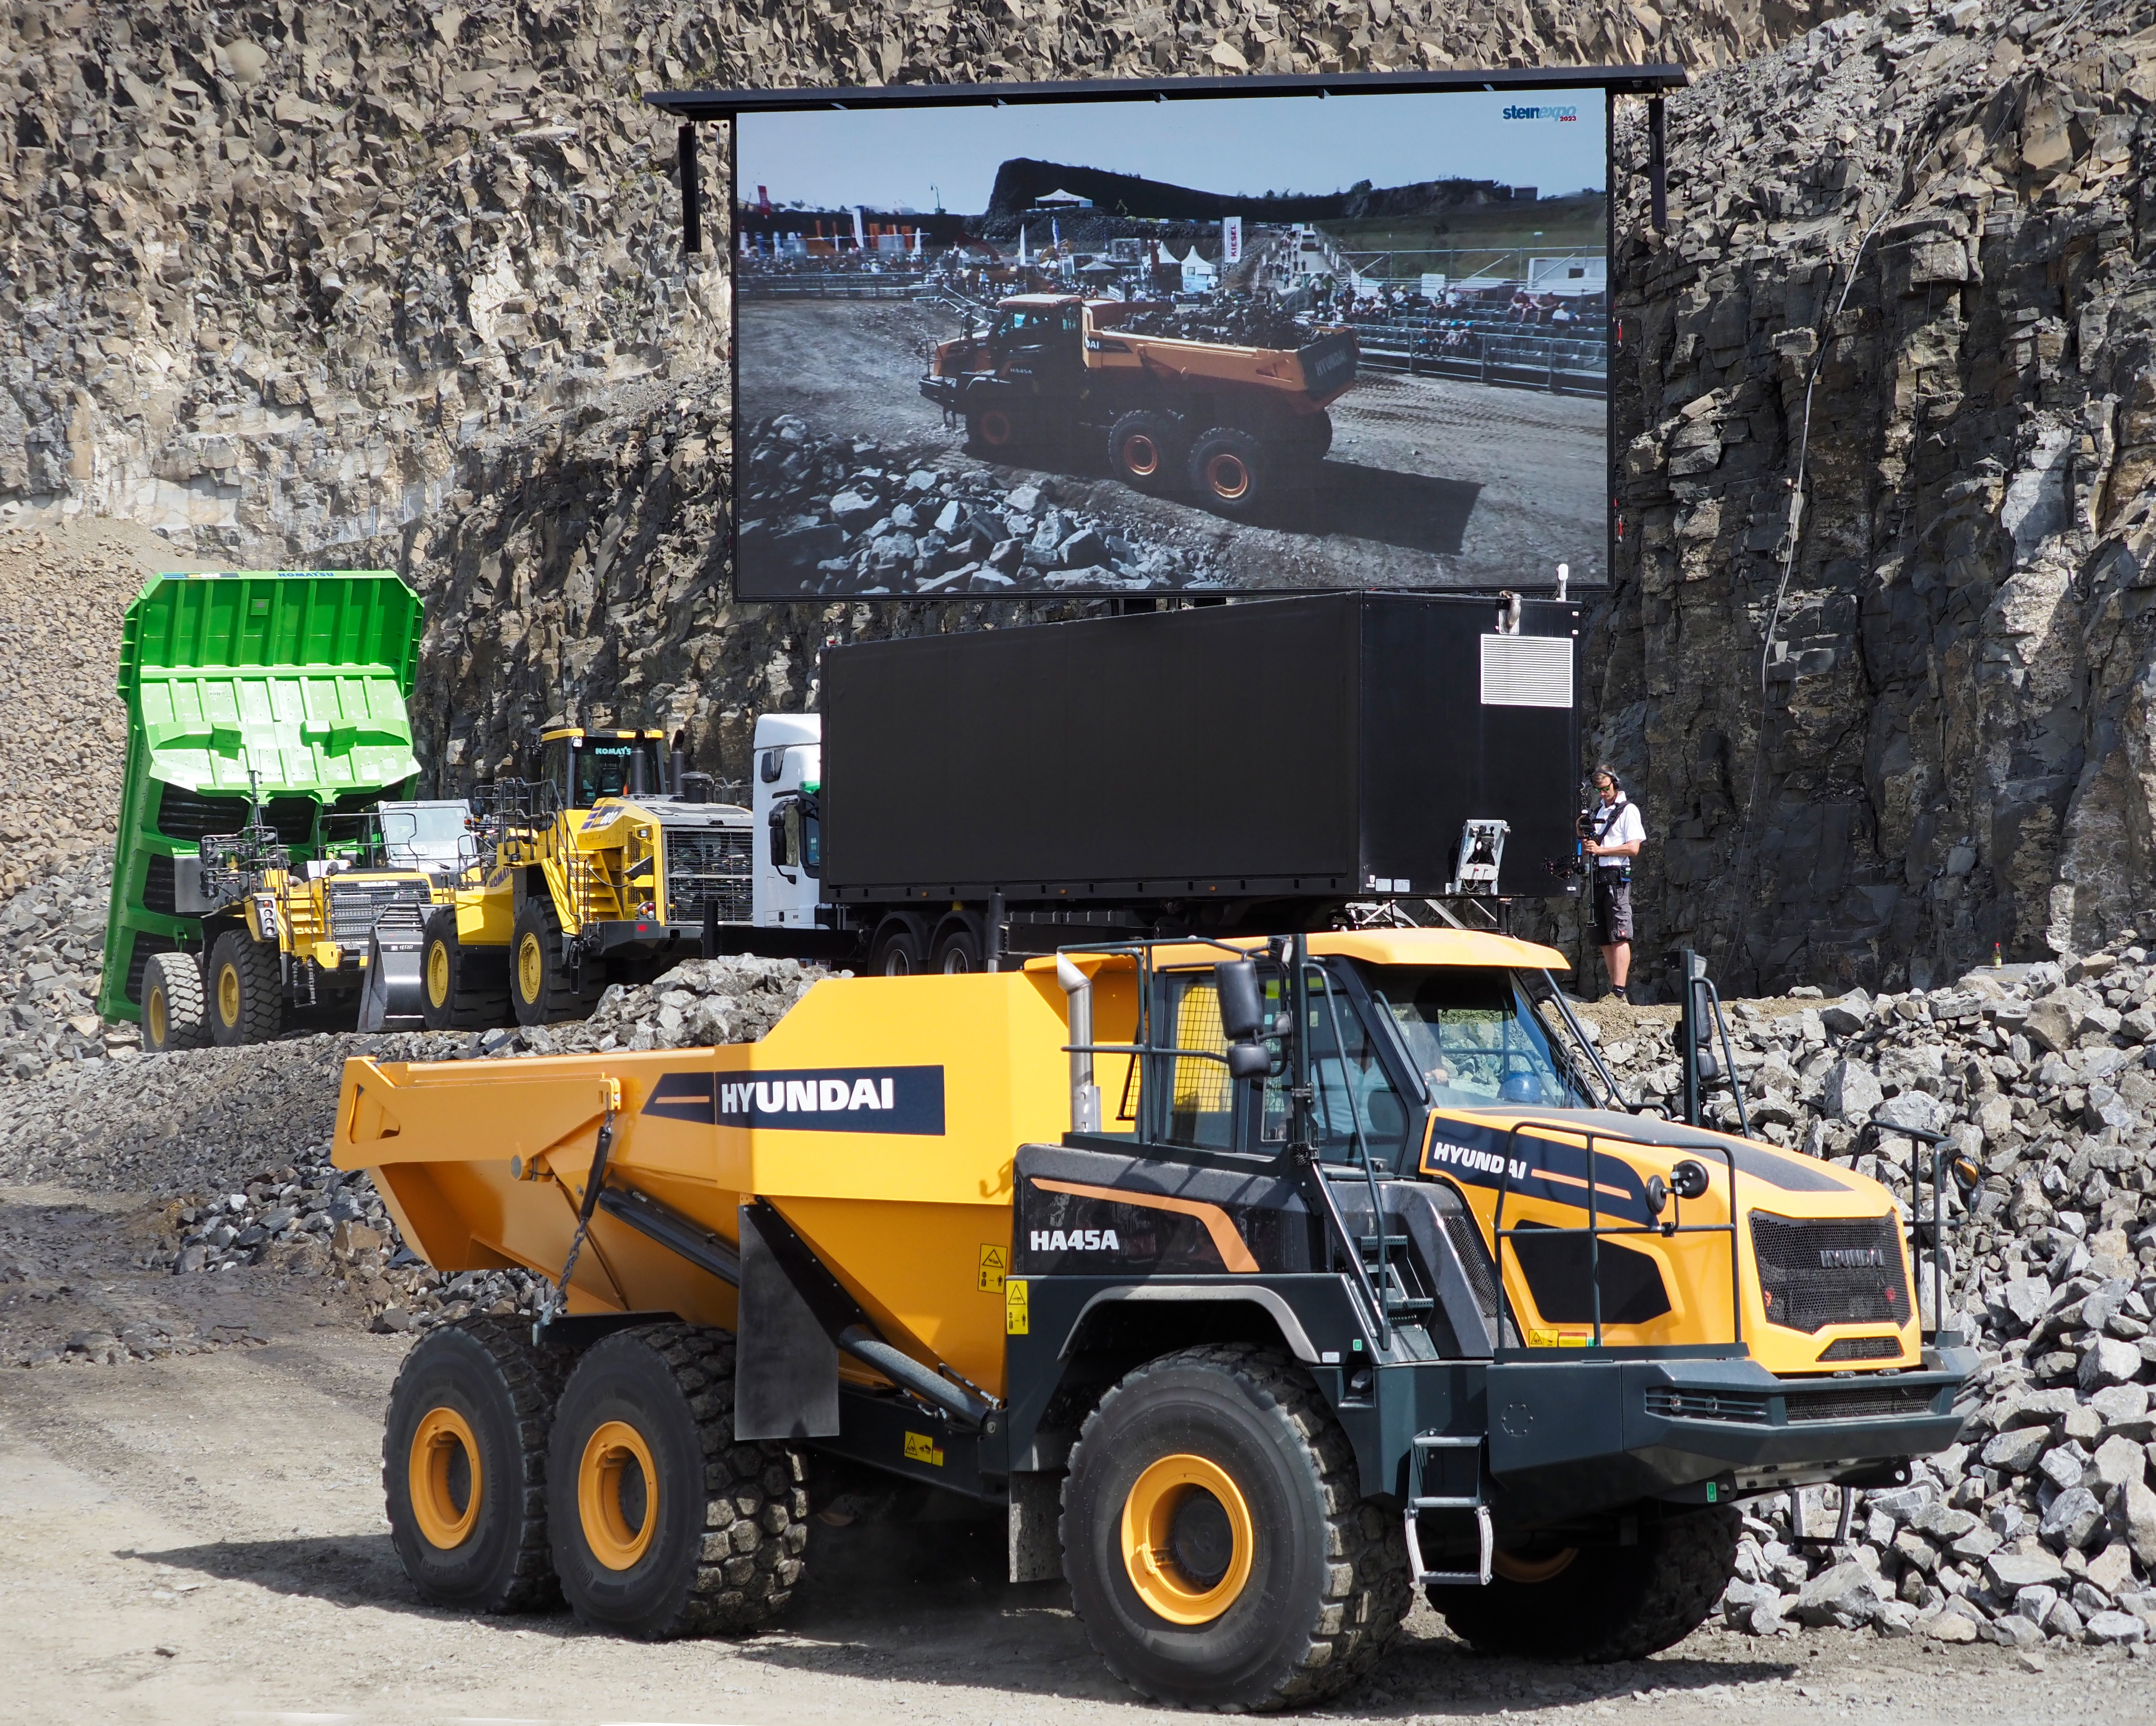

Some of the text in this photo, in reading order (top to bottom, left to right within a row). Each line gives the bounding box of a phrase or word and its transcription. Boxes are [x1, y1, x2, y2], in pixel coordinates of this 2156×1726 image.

[1502, 105, 1577, 122] steinexpo
[595, 746, 632, 755] KOMATS
[721, 1078, 894, 1114] HYUNDAI
[1433, 1141, 1527, 1179] HYUNDAI
[1030, 1229, 1119, 1251] HA45A
[1819, 1249, 1885, 1268] HYUNDAI
